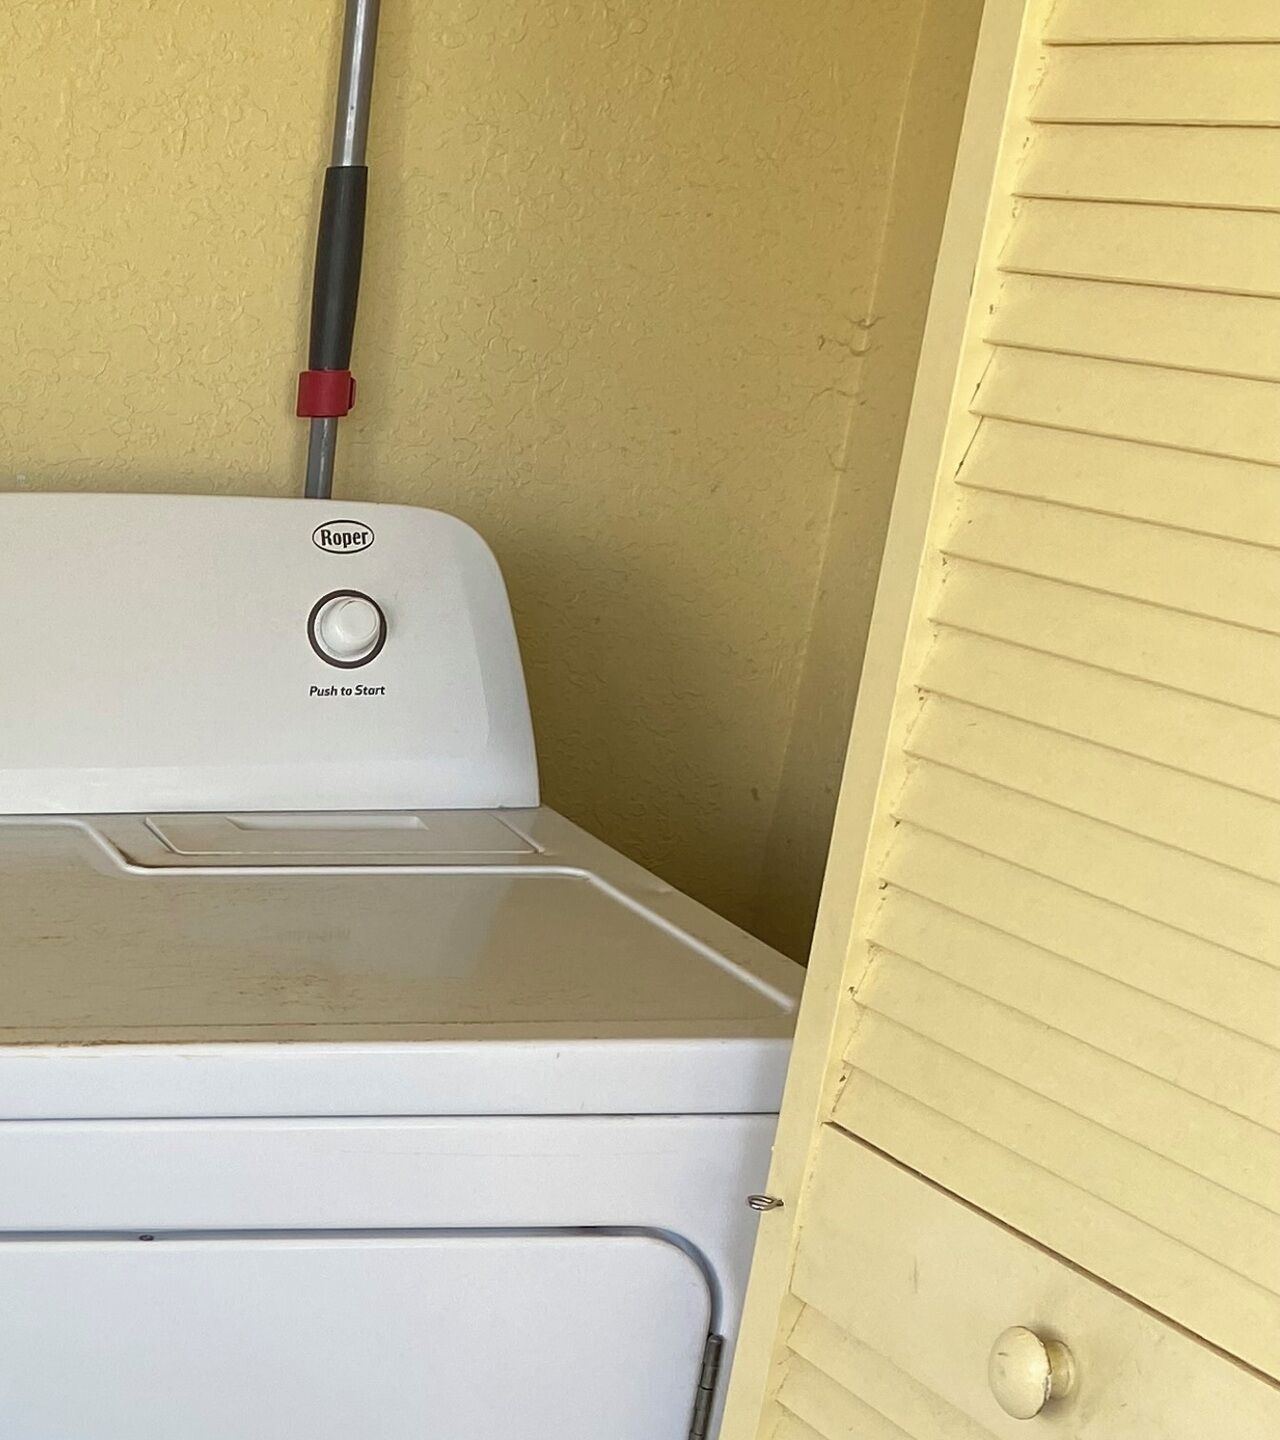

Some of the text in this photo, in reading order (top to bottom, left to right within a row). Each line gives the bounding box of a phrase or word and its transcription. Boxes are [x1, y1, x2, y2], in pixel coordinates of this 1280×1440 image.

[321, 529, 368, 548] Roper
[310, 685, 385, 696] Push to Start
